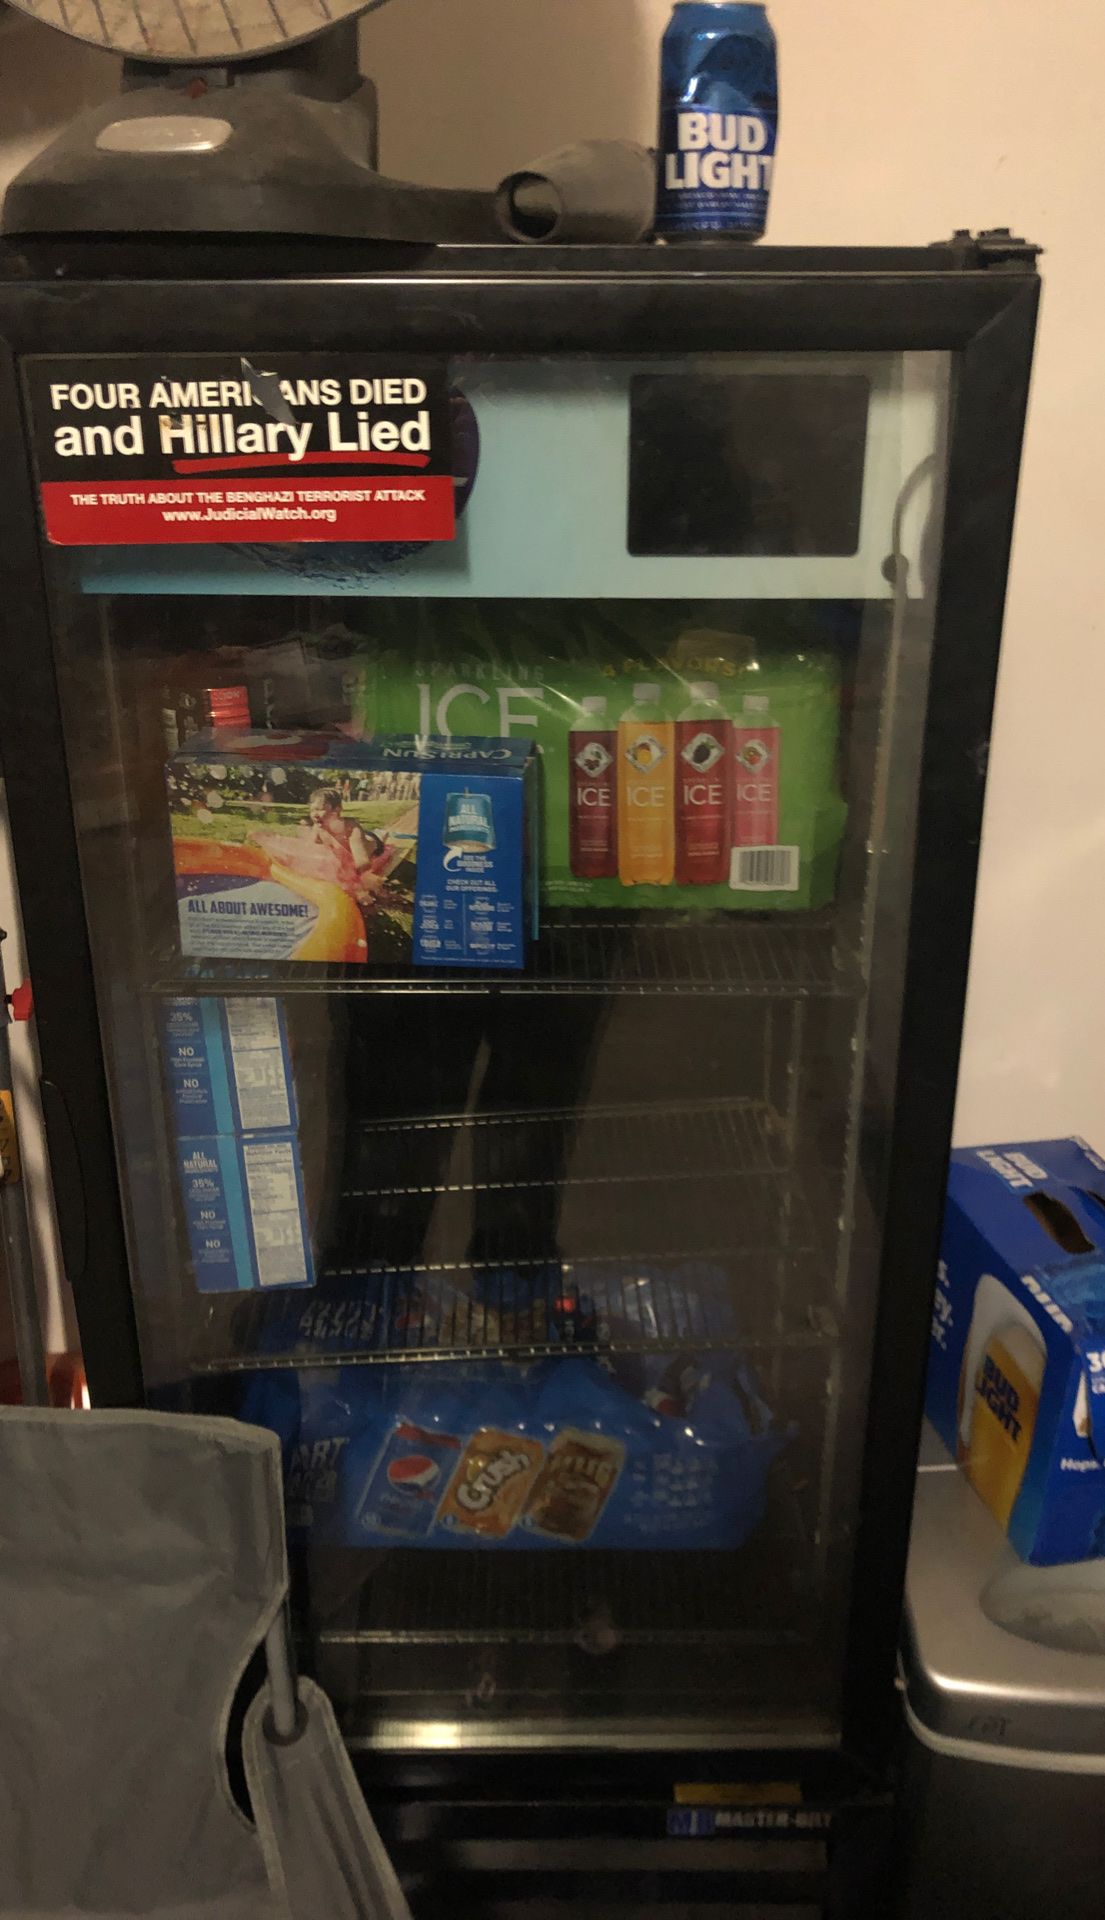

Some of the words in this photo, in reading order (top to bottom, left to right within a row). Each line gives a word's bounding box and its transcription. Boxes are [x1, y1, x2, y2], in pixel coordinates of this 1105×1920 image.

[678, 112, 767, 152] BUD
[665, 150, 774, 190] LIGHT
[50, 383, 141, 410] FOUR
[149, 379, 342, 408] AMERIANS
[350, 378, 427, 405] DIED
[54, 416, 144, 456] and
[159, 413, 313, 461] Hillary
[327, 411, 431, 453] Lied
[70, 494, 98, 506] THE
[100, 493, 145, 505] TRUTH
[148, 492, 193, 504] ABOUT
[196, 492, 224, 504] THE
[225, 491, 294, 503] BENGHAZI
[297, 490, 371, 502] TERRORIST
[374, 489, 426, 501] ATTACK
[162, 507, 337, 523] www.JudicialWatch.org
[577, 788, 611, 807] ICE
[627, 786, 666, 807] ICE
[684, 784, 722, 806] ICE
[736, 784, 772, 802] ICE
[188, 900, 208, 913] ALL
[210, 901, 247, 915] ABOUT
[250, 903, 308, 918] AWESOME!
[178, 1047, 194, 1057] NO
[183, 1079, 199, 1088] NO
[184, 1159, 217, 1169] NATURAL
[193, 1151, 205, 1160] ALL
[200, 1210, 215, 1219] NO
[205, 1240, 220, 1249] NO
[457, 1449, 530, 1511] Crush
